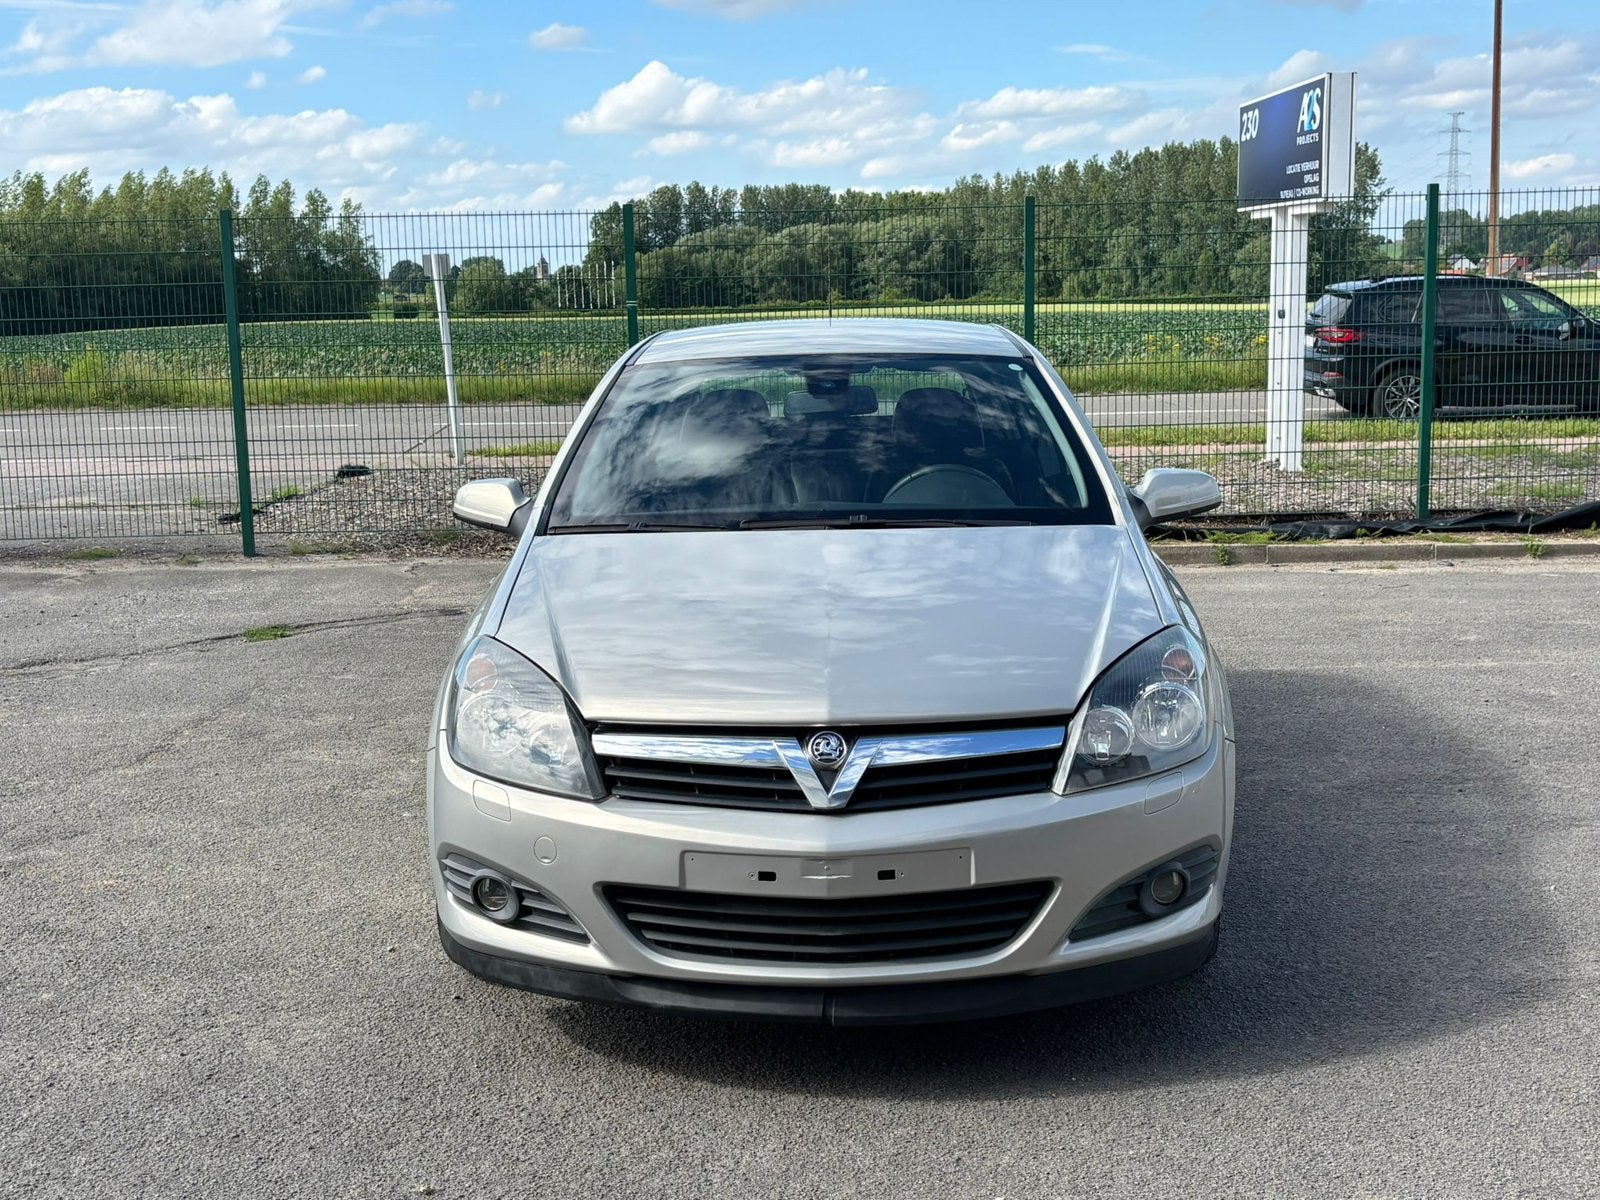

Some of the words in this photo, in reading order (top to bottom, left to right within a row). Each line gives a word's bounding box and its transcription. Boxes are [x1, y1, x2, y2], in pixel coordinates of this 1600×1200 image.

[1241, 108, 1259, 142] 230
[1296, 133, 1319, 146] PROJECTS
[1286, 163, 1301, 174] LOCATIE
[1301, 160, 1319, 172] VERHUUR
[1304, 173, 1319, 184] OPSLAG
